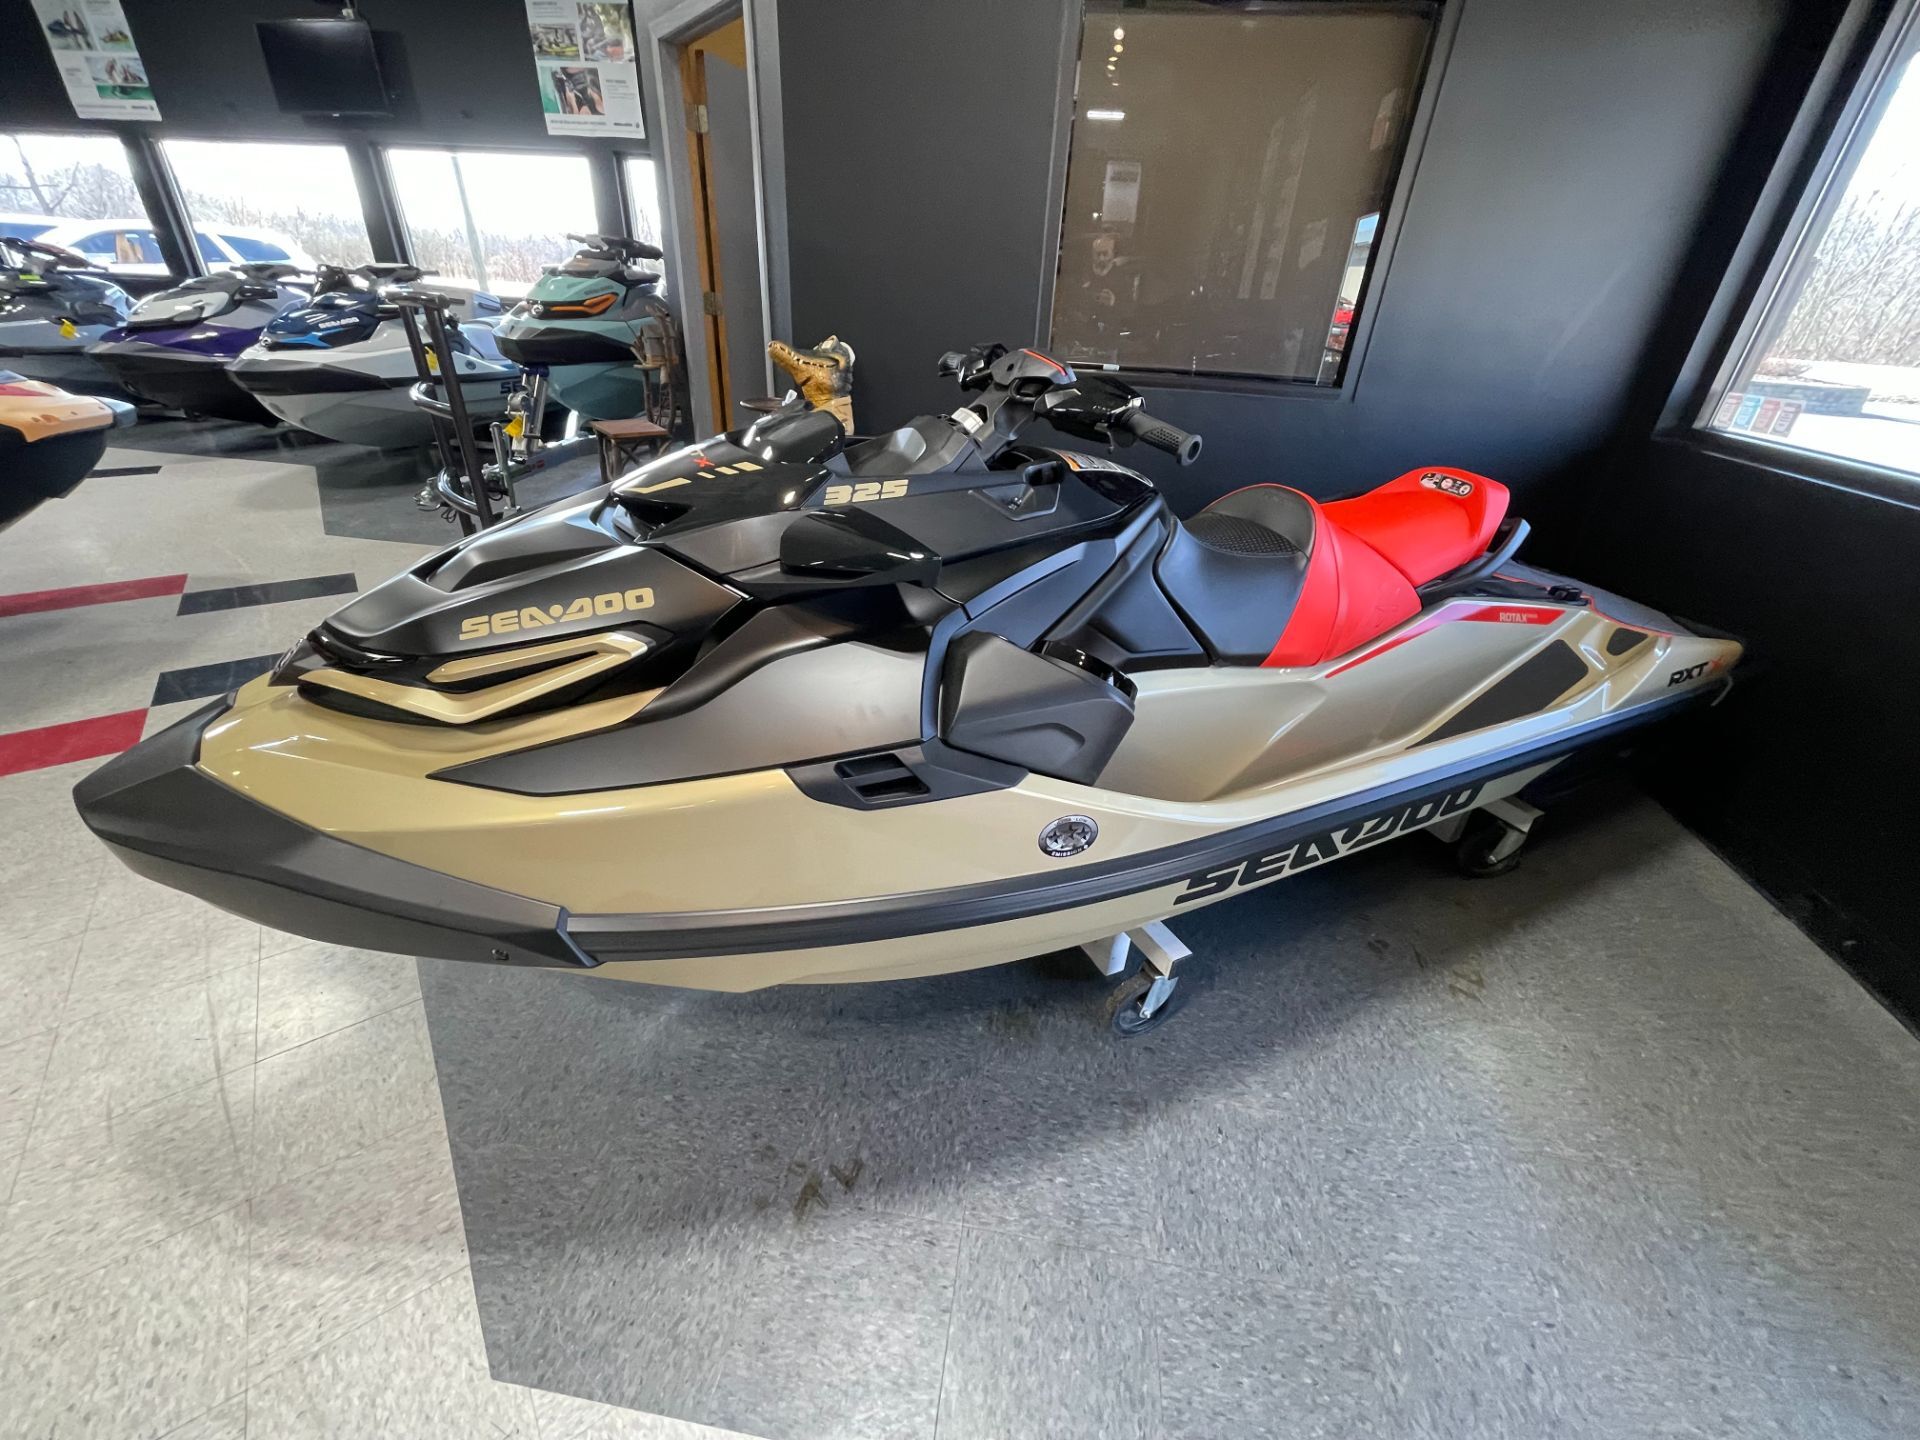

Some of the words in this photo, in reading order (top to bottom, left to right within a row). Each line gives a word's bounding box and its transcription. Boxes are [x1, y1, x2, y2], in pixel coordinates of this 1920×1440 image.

[823, 479, 909, 506] 325
[1499, 612, 1528, 624] ROTAX
[1666, 660, 1710, 688] RXT
